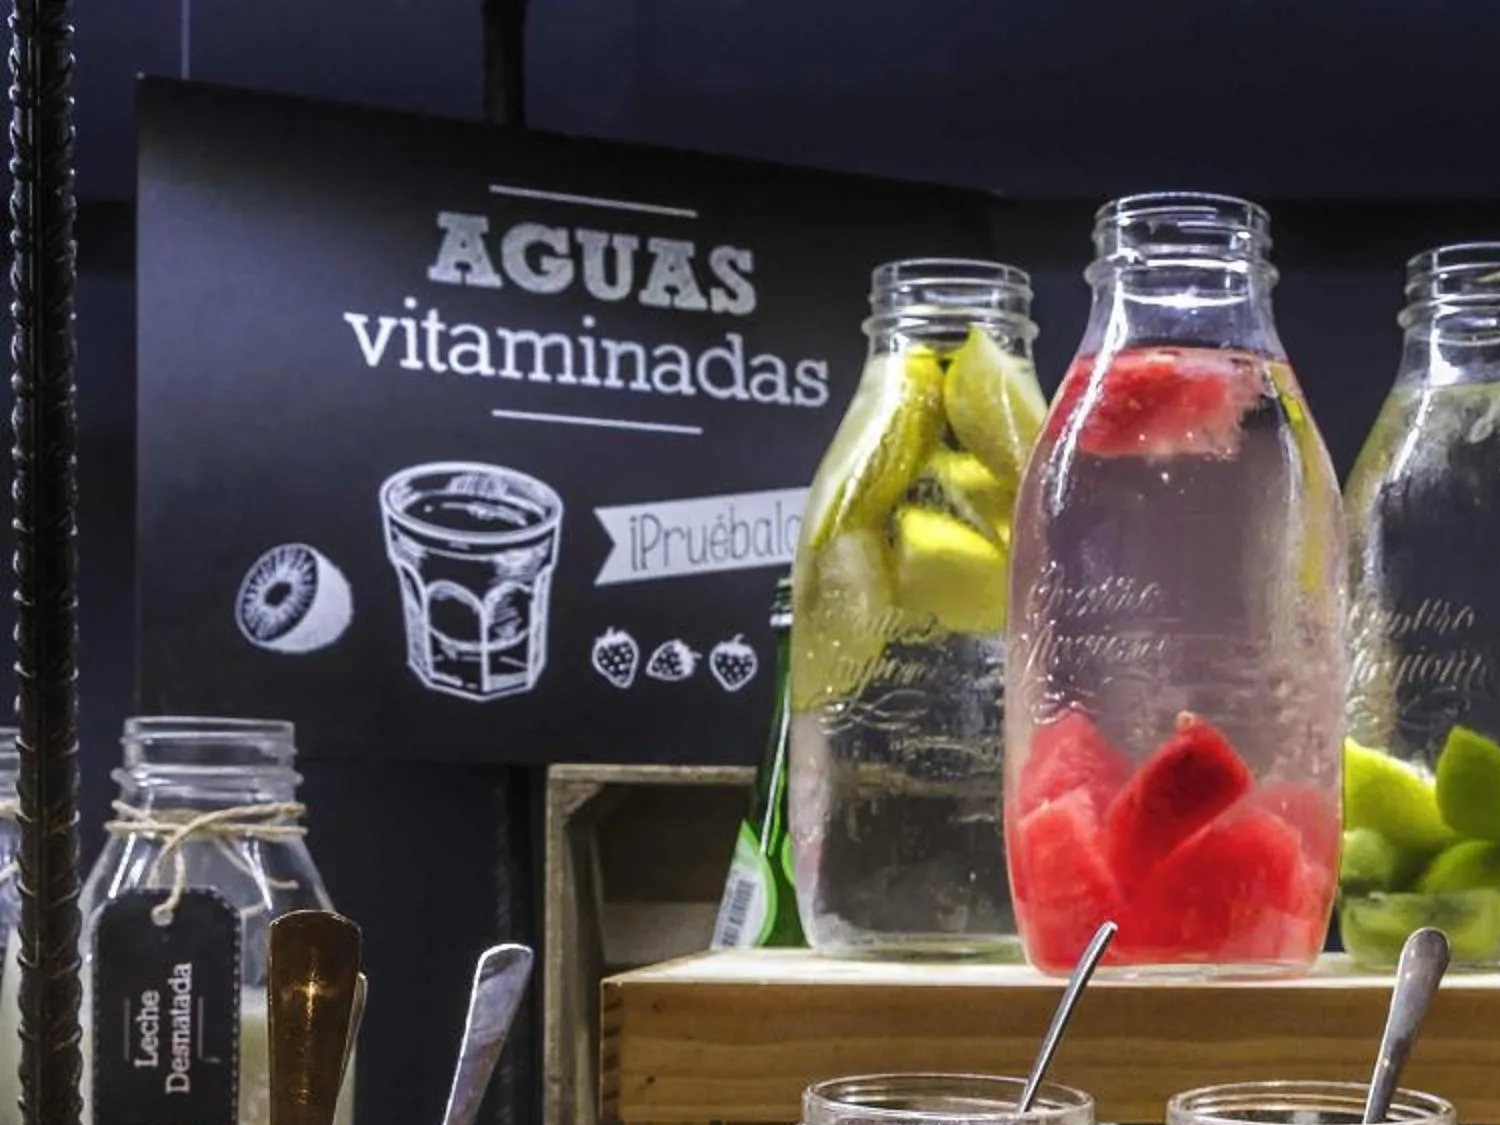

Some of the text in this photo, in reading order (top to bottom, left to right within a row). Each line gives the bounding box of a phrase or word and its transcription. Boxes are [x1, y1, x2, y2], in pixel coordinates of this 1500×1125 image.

[428, 211, 757, 315] AGUAS
[343, 297, 830, 407] vitaminadas
[134, 988, 161, 1068] Leche
[165, 962, 193, 1094] Desnatada
